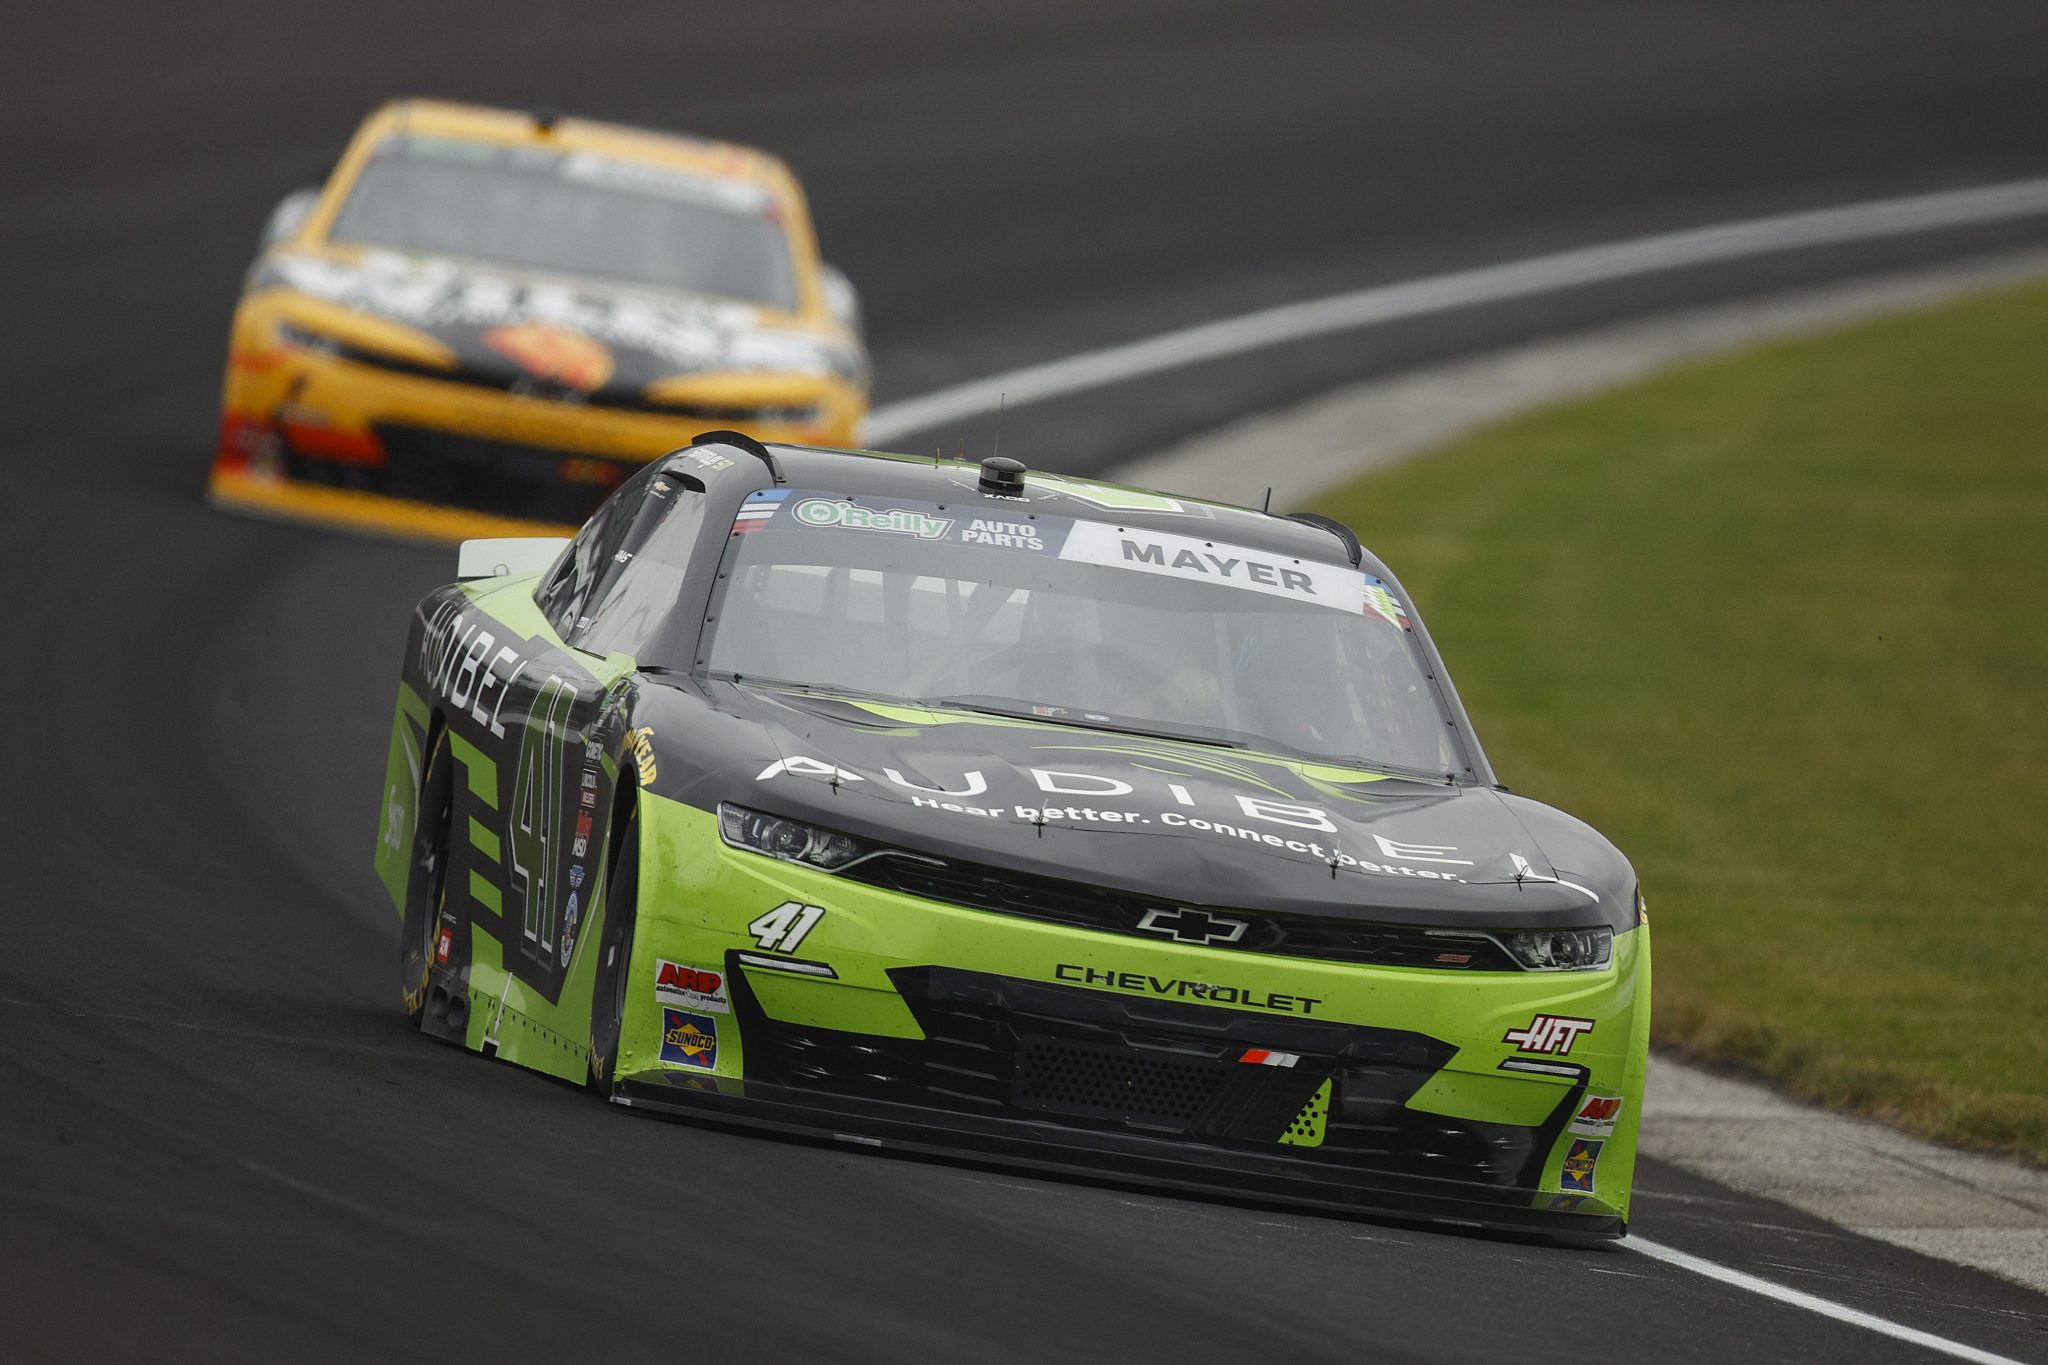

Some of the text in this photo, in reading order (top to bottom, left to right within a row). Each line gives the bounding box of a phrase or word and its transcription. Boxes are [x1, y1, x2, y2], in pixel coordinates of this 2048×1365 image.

[797, 498, 947, 539] O'Reilly
[962, 530, 1043, 550] PARTS
[969, 519, 1036, 537] AUTO
[1121, 539, 1316, 595] MAYER
[510, 674, 578, 954] 41
[756, 756, 1600, 903] AUDIBEL
[911, 796, 1467, 884] Hear better. Connect better.
[748, 901, 825, 955] 41
[656, 962, 722, 995] ARP
[1055, 963, 1322, 1014] CHEVROLET
[668, 1030, 714, 1050] SUNOCO
[1502, 1014, 1596, 1056] HFT
